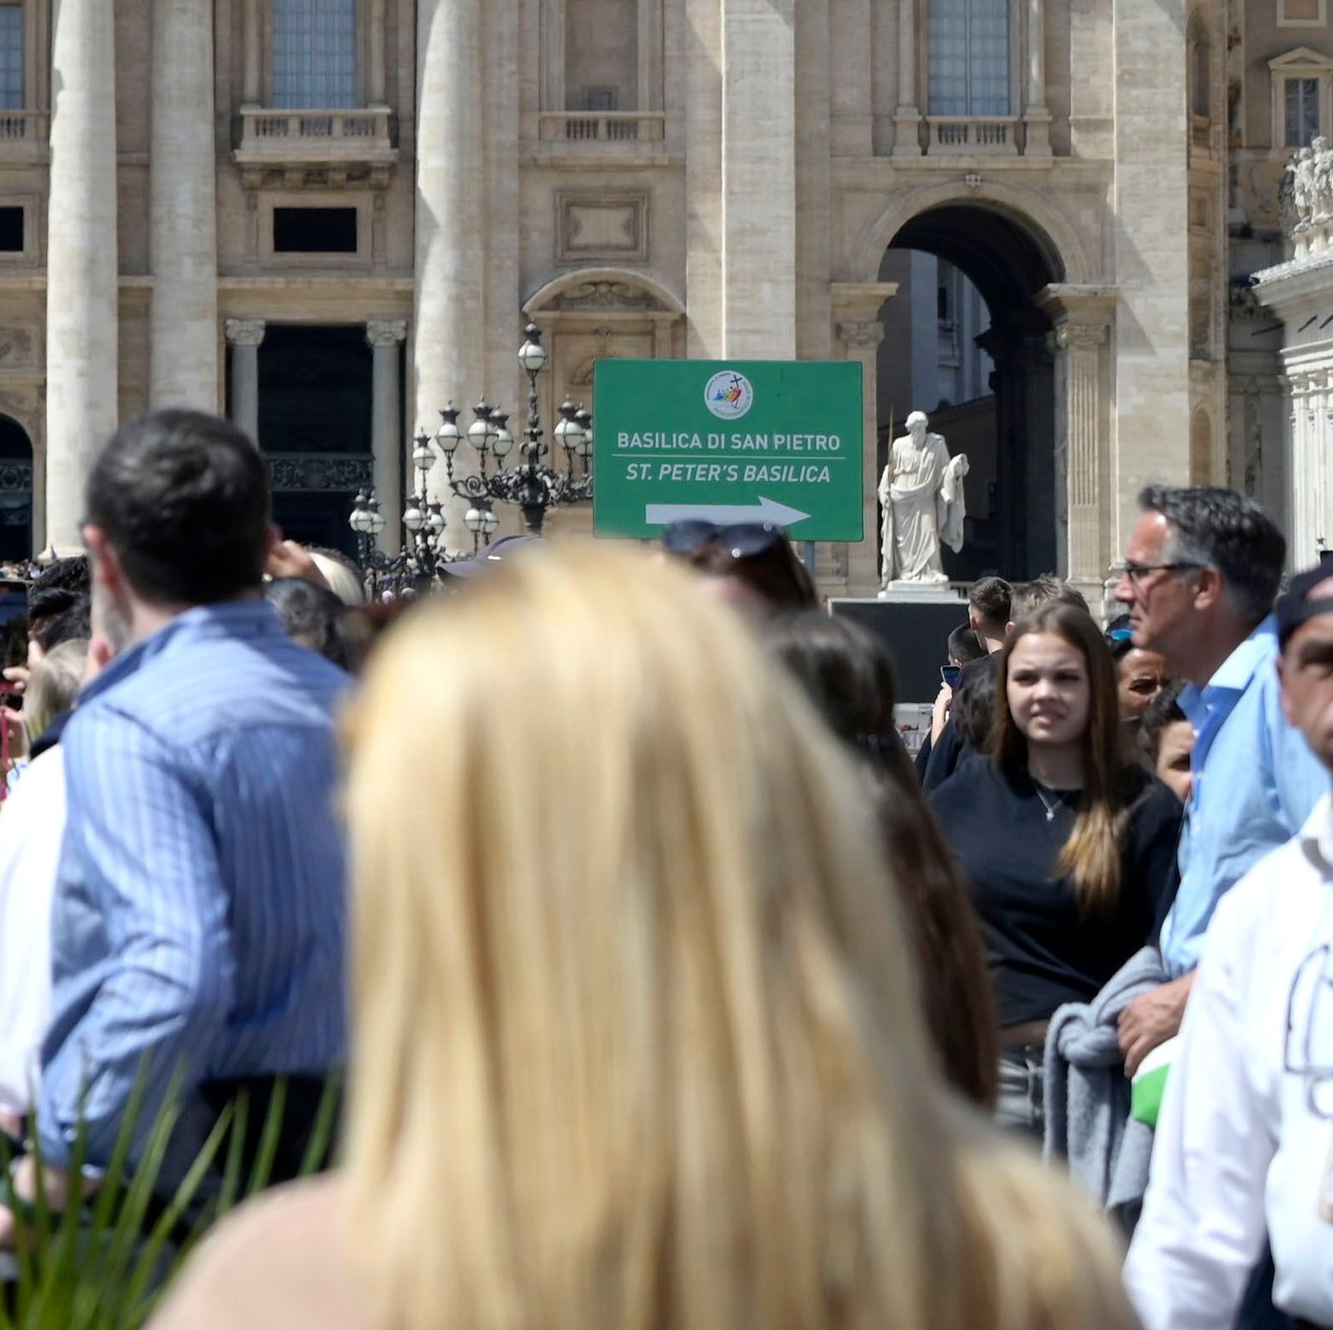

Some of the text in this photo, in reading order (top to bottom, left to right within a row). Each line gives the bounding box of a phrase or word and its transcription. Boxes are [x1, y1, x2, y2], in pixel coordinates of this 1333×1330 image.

[617, 432, 840, 451] BASILICA DI SAN PIETRO
[625, 463, 831, 483] ST. PETER'S BASILICA
